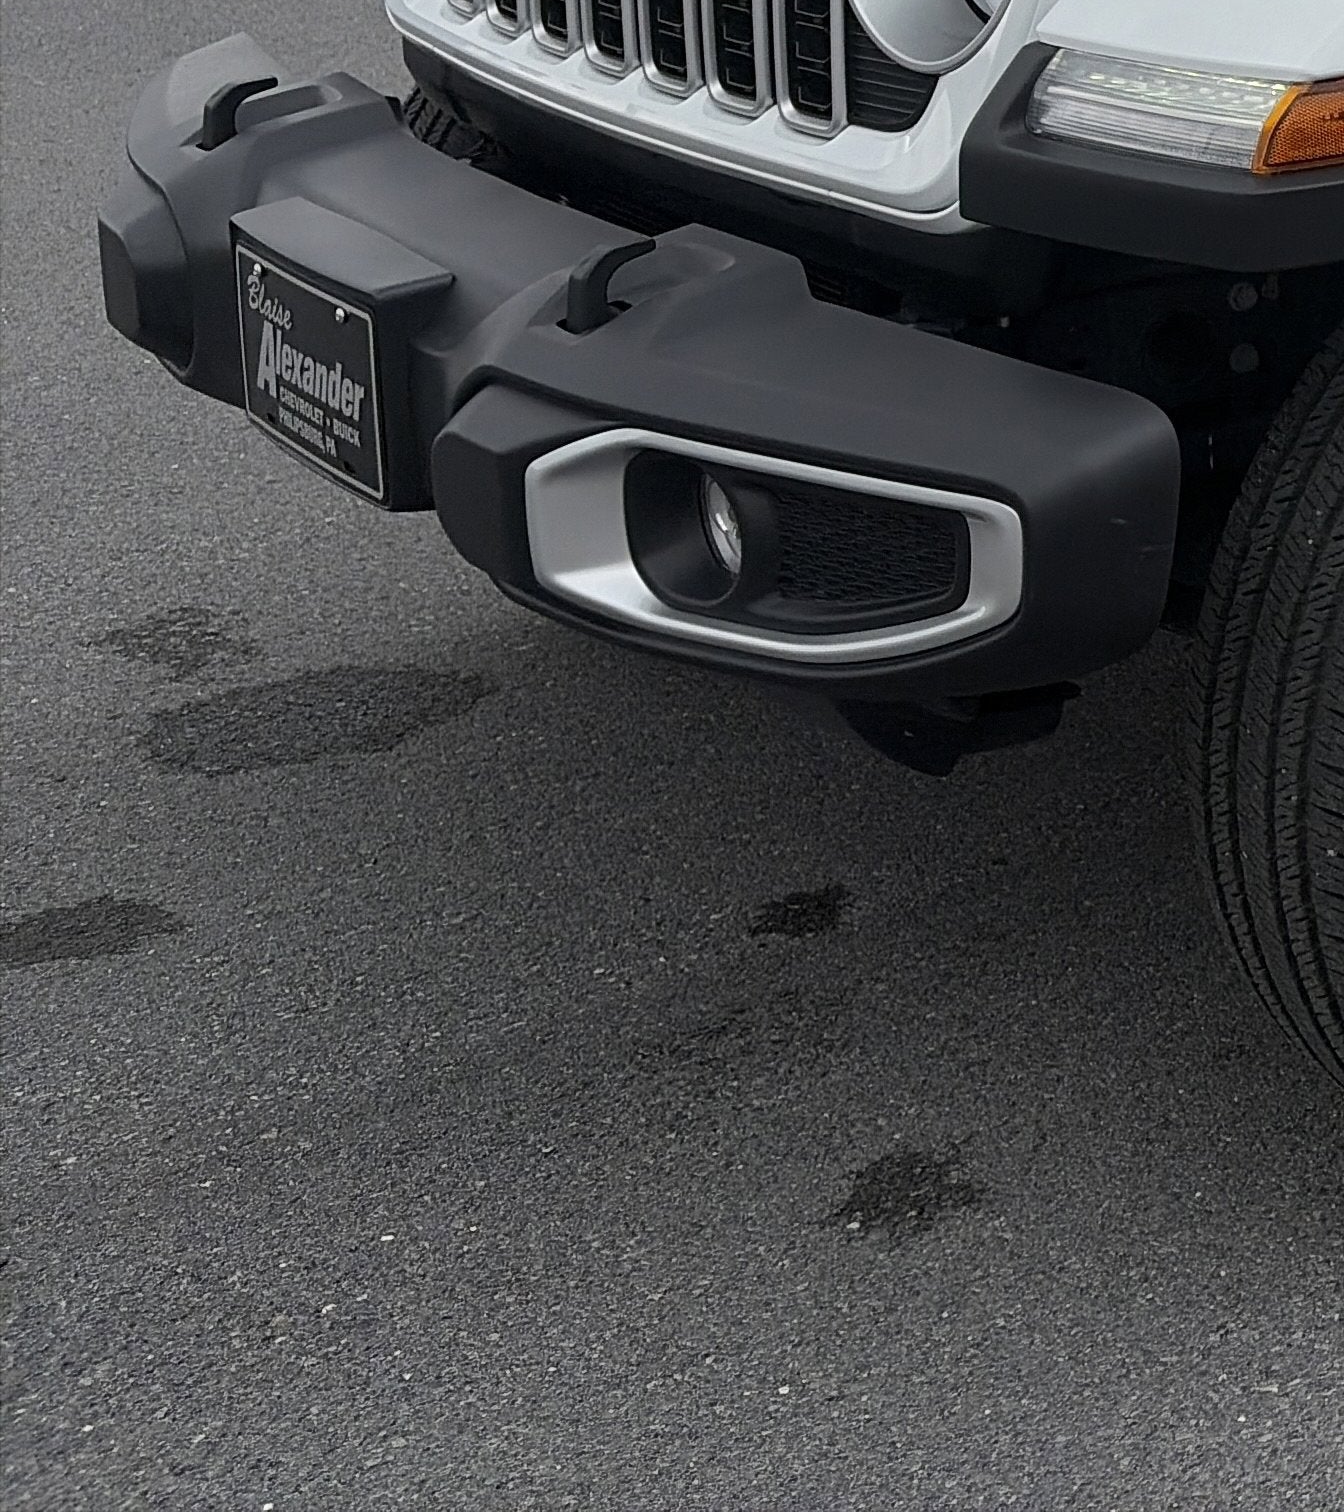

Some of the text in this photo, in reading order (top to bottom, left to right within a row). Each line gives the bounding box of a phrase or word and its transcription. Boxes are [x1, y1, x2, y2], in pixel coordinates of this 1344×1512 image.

[247, 274, 293, 331] Blaise
[256, 319, 365, 422] Alexander
[279, 385, 361, 449] CHEVROLET BUICK
